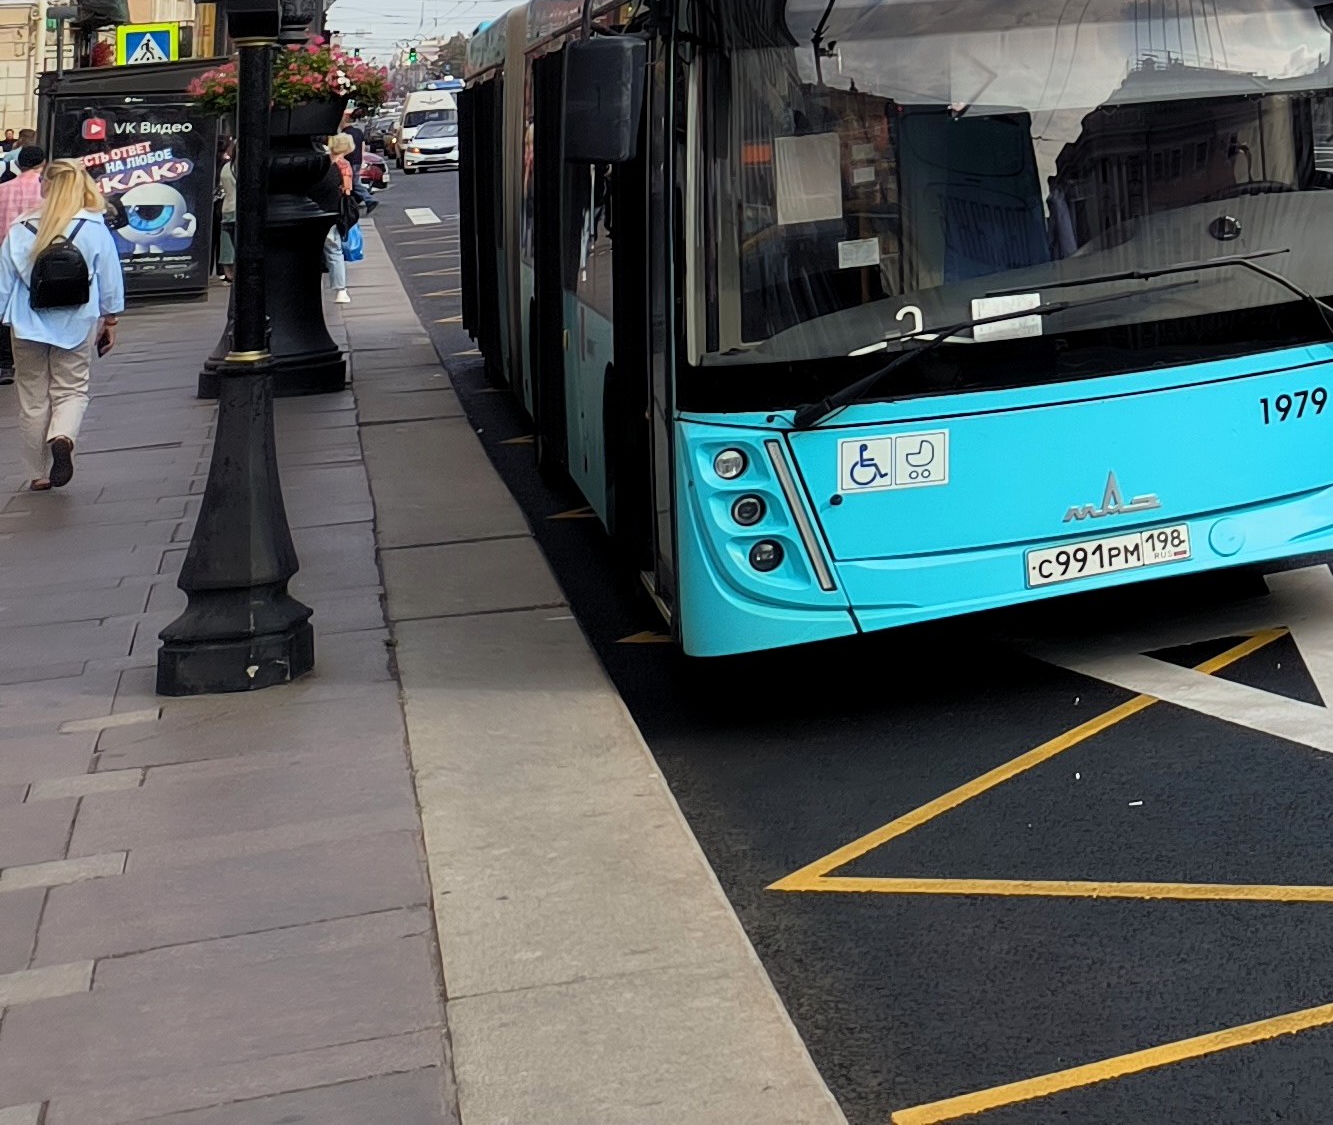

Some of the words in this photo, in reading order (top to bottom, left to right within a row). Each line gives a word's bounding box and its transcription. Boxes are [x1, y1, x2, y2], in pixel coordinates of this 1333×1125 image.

[113, 122, 136, 134] VK
[140, 121, 192, 135] Видео
[105, 161, 125, 174] НА
[126, 148, 173, 169] ЛЮБОЕ
[111, 141, 151, 160] ОТВЕТ
[1260, 386, 1327, 425] 1979
[1145, 528, 1186, 552] 198
[1154, 550, 1173, 560] RUS
